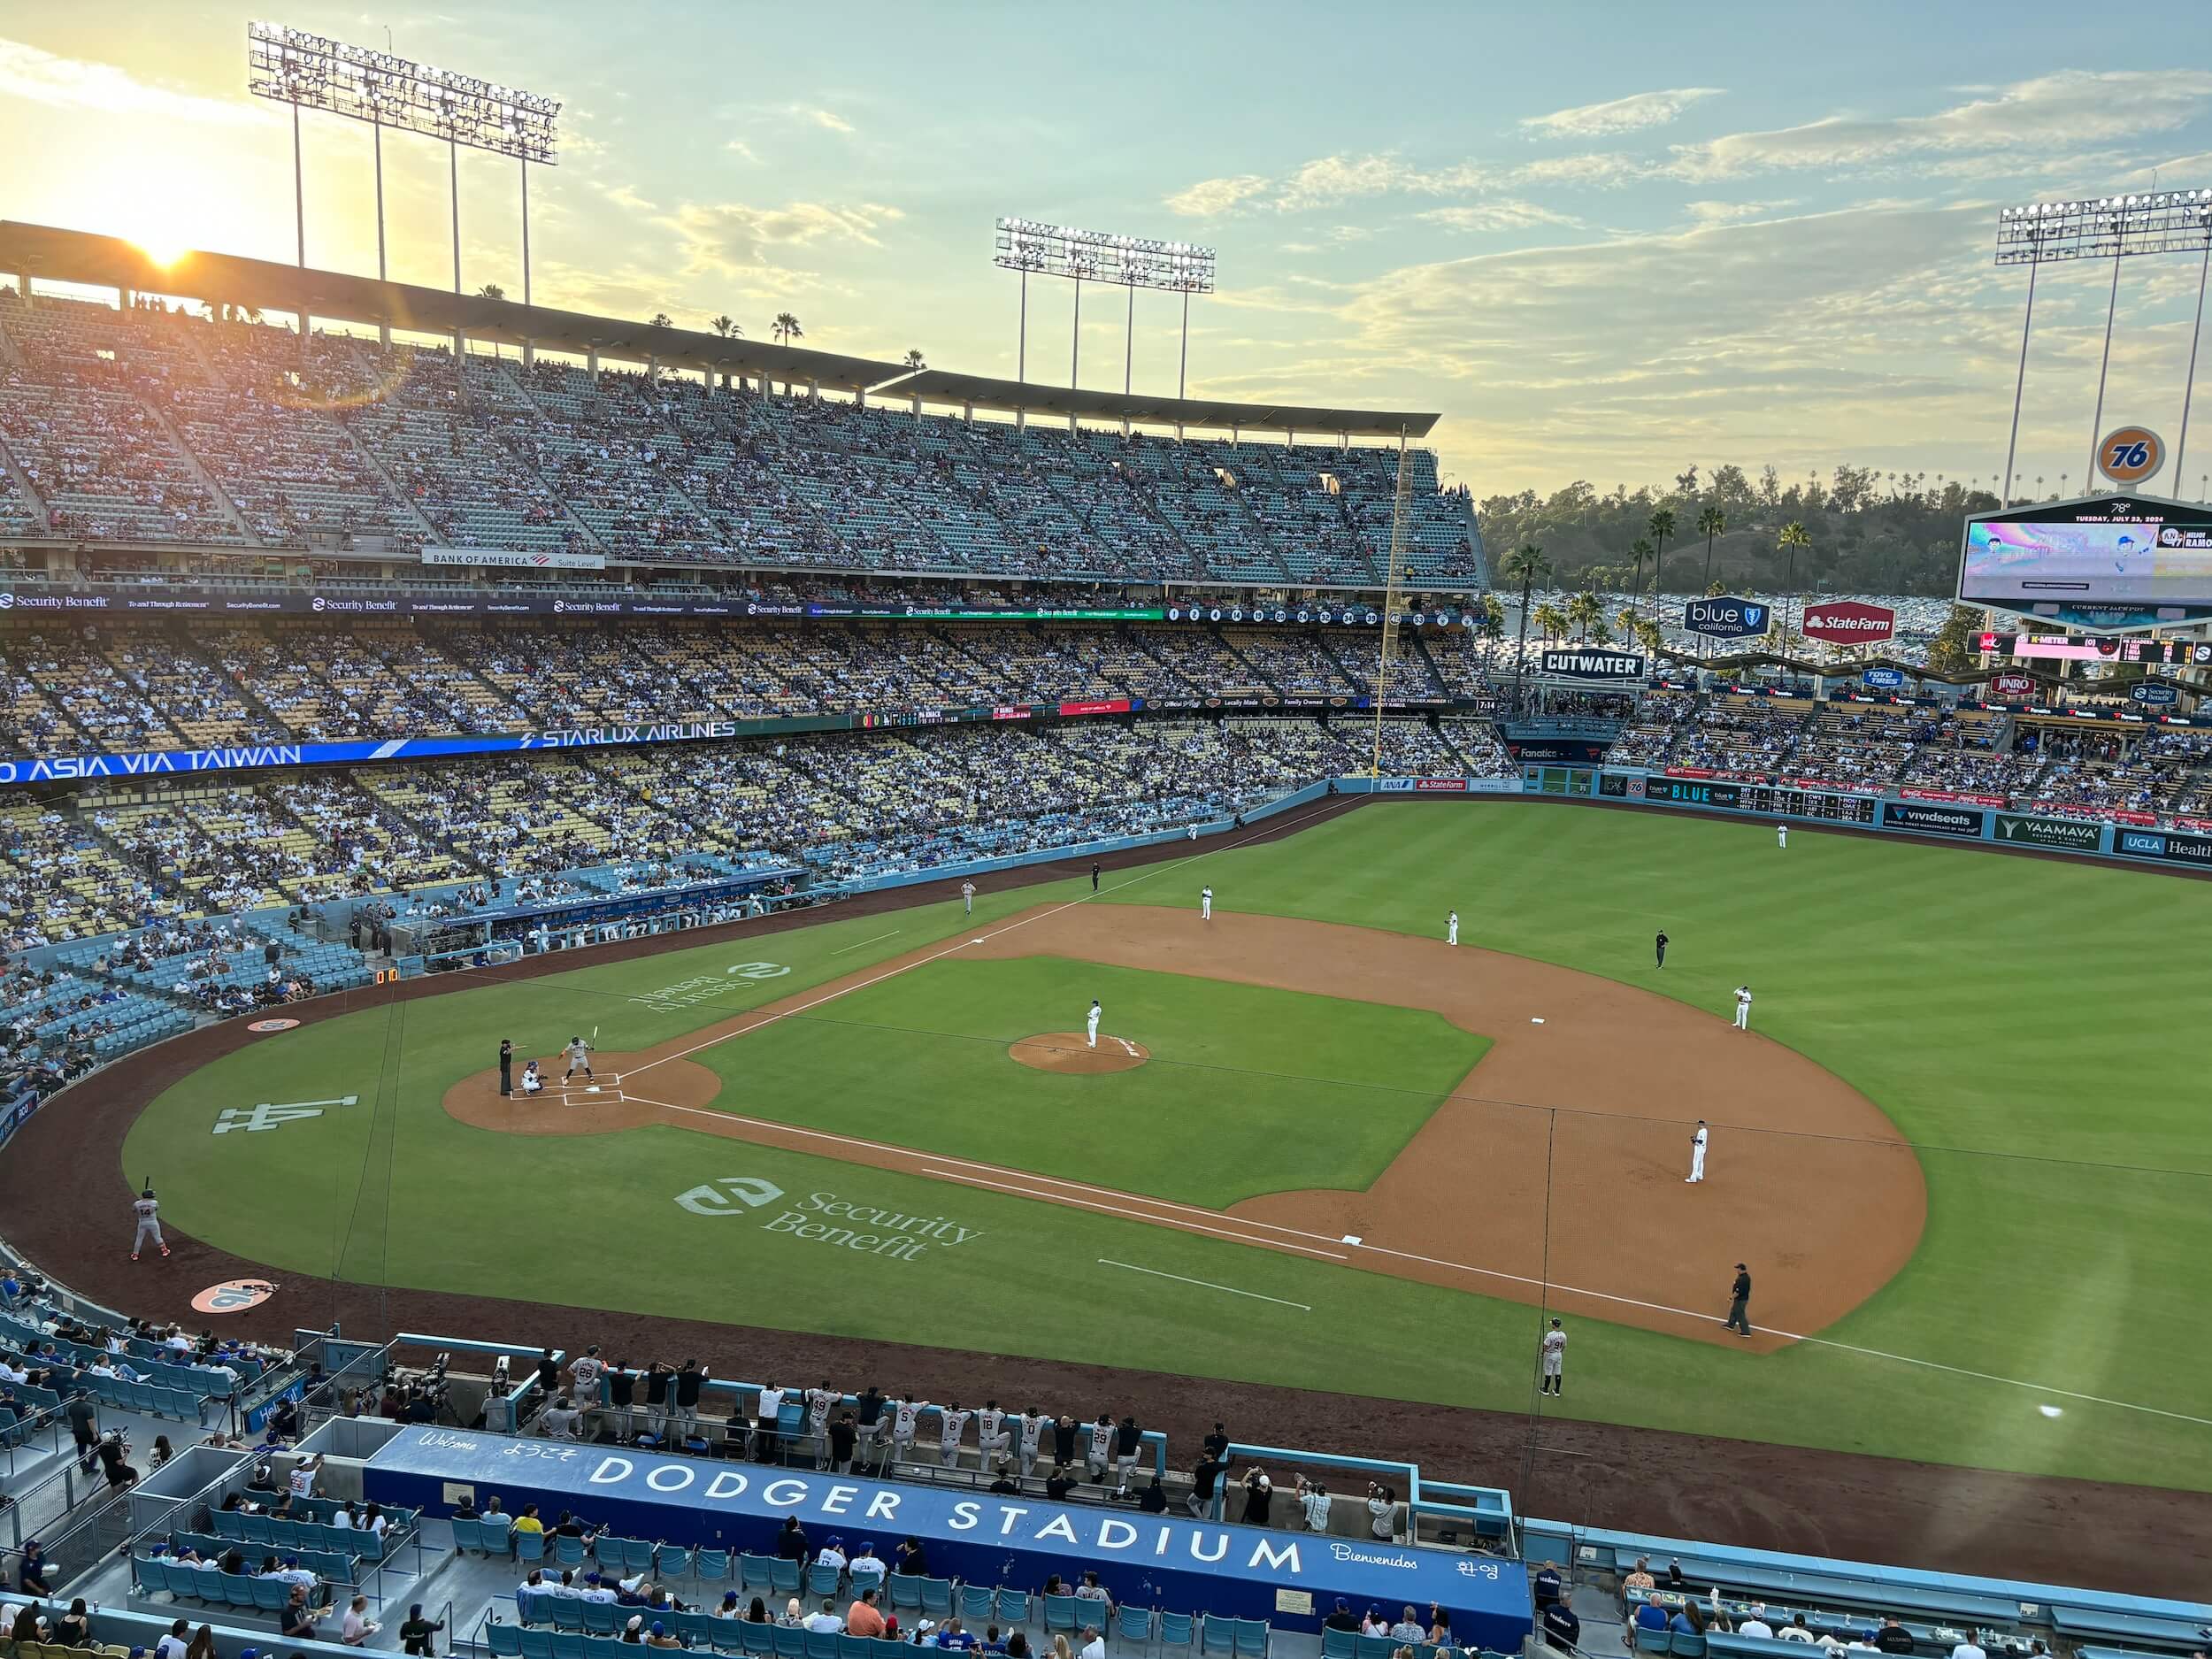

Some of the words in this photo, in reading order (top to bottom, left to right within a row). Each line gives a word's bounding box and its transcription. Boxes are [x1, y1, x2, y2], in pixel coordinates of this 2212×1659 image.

[2109, 441, 2149, 468] 76
[2111, 503, 2131, 513] 78°
[434, 555, 464, 564] BANK
[480, 556, 527, 565] AMERICA
[16, 595, 63, 609] Security
[327, 600, 362, 611] Security
[565, 603, 594, 612] Security
[757, 605, 780, 614] Security
[1692, 603, 1739, 623] blue
[1698, 623, 1743, 633] california
[1547, 654, 1637, 675] CUTWATER
[1999, 678, 2029, 689] JINRO
[543, 726, 640, 748] STARLUX
[647, 722, 735, 741] AIRLINES
[29, 757, 111, 781] ASIA
[121, 752, 175, 773] VIA
[184, 746, 300, 770] TAIWAN
[1628, 782, 1642, 793] 76
[1672, 785, 1710, 802] BLUE
[1909, 811, 1970, 826] vividseats
[2129, 838, 2159, 850] UCLA
[628, 976, 725, 1003] Benefit
[648, 980, 755, 1012] Security
[795, 1191, 986, 1247] Security
[759, 1210, 928, 1261] Benefit
[580, 1368, 594, 1379] 26
[814, 1401, 826, 1411] 49
[901, 1413, 909, 1422] 5
[949, 1421, 956, 1431] 8
[983, 1420, 993, 1430] 18
[1028, 1425, 1034, 1434] 0
[419, 1431, 478, 1451] Welcome
[1094, 1434, 1107, 1444] 29
[503, 1442, 580, 1462] ようこそ
[588, 1457, 902, 1520] DODGER
[948, 1502, 1302, 1573] STADIUM
[1330, 1543, 1417, 1570] Bienvenidos
[1455, 1561, 1498, 1579] 환영
